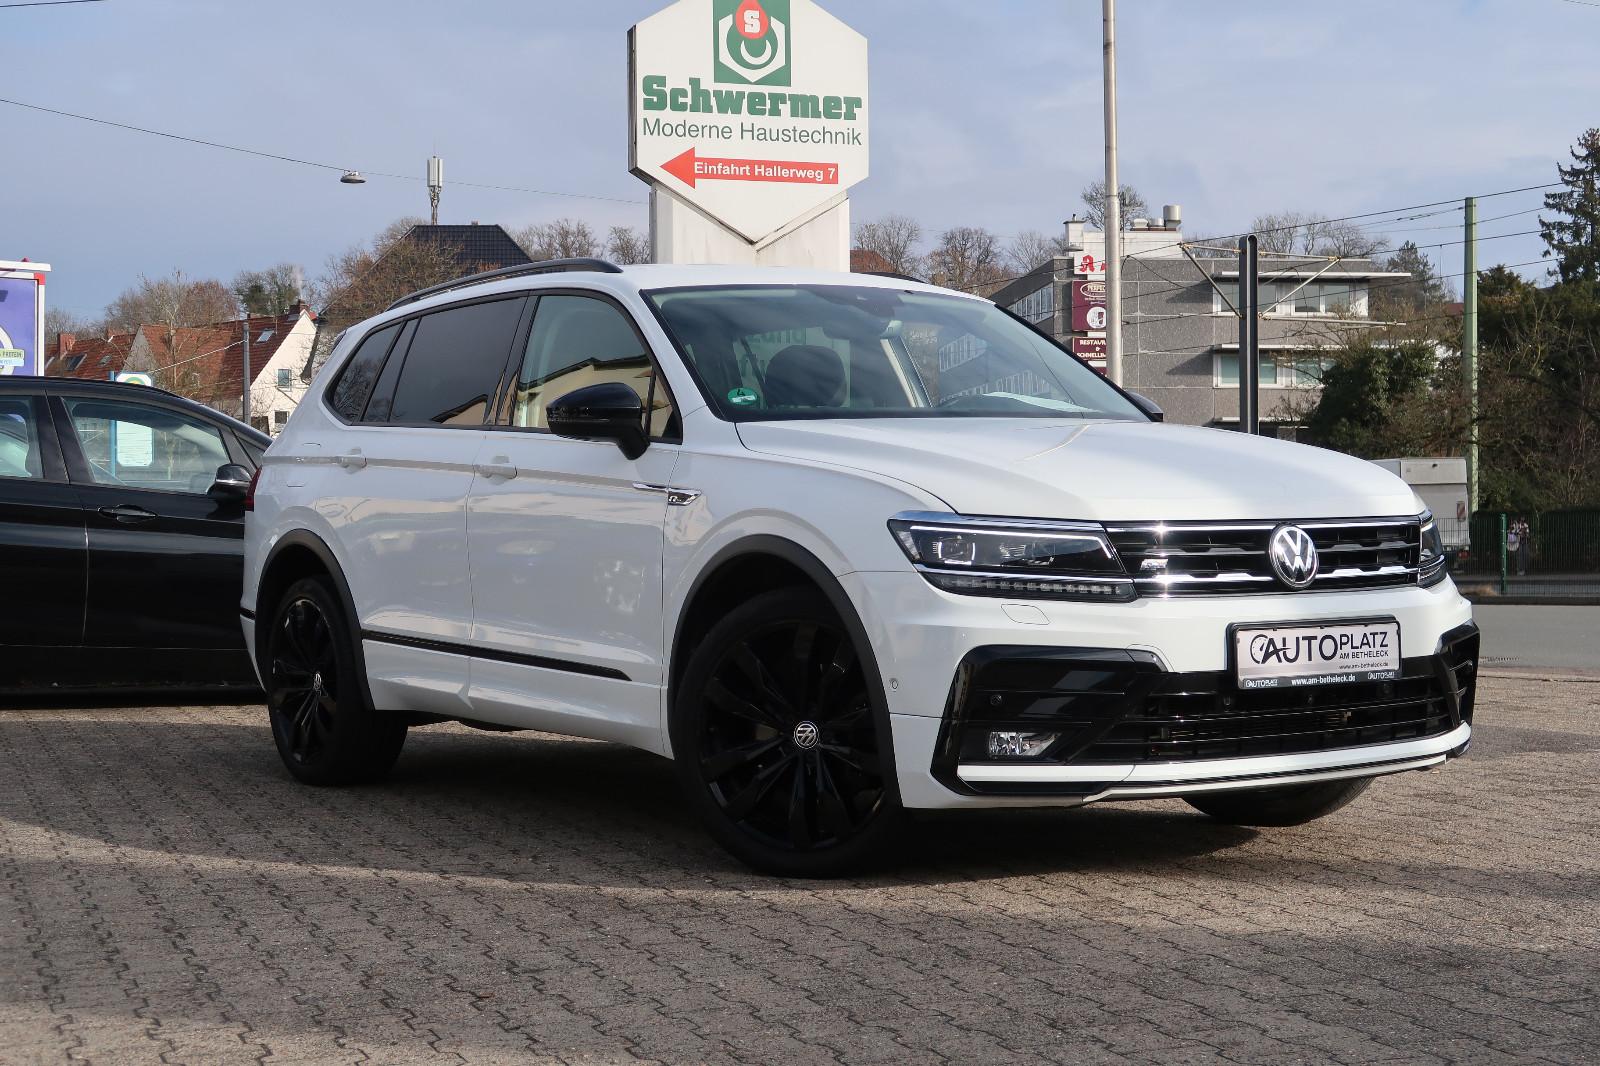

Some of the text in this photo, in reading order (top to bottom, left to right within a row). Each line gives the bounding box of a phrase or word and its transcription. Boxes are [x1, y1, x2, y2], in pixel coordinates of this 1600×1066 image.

[642, 75, 863, 121] Schwermer
[642, 118, 862, 146] Moderne Haustechnik
[694, 161, 836, 181] Einfahrt Hallerweg 7
[1351, 650, 1389, 659] BETHELECK
[1291, 674, 1356, 686] www.am-betheleck.de
